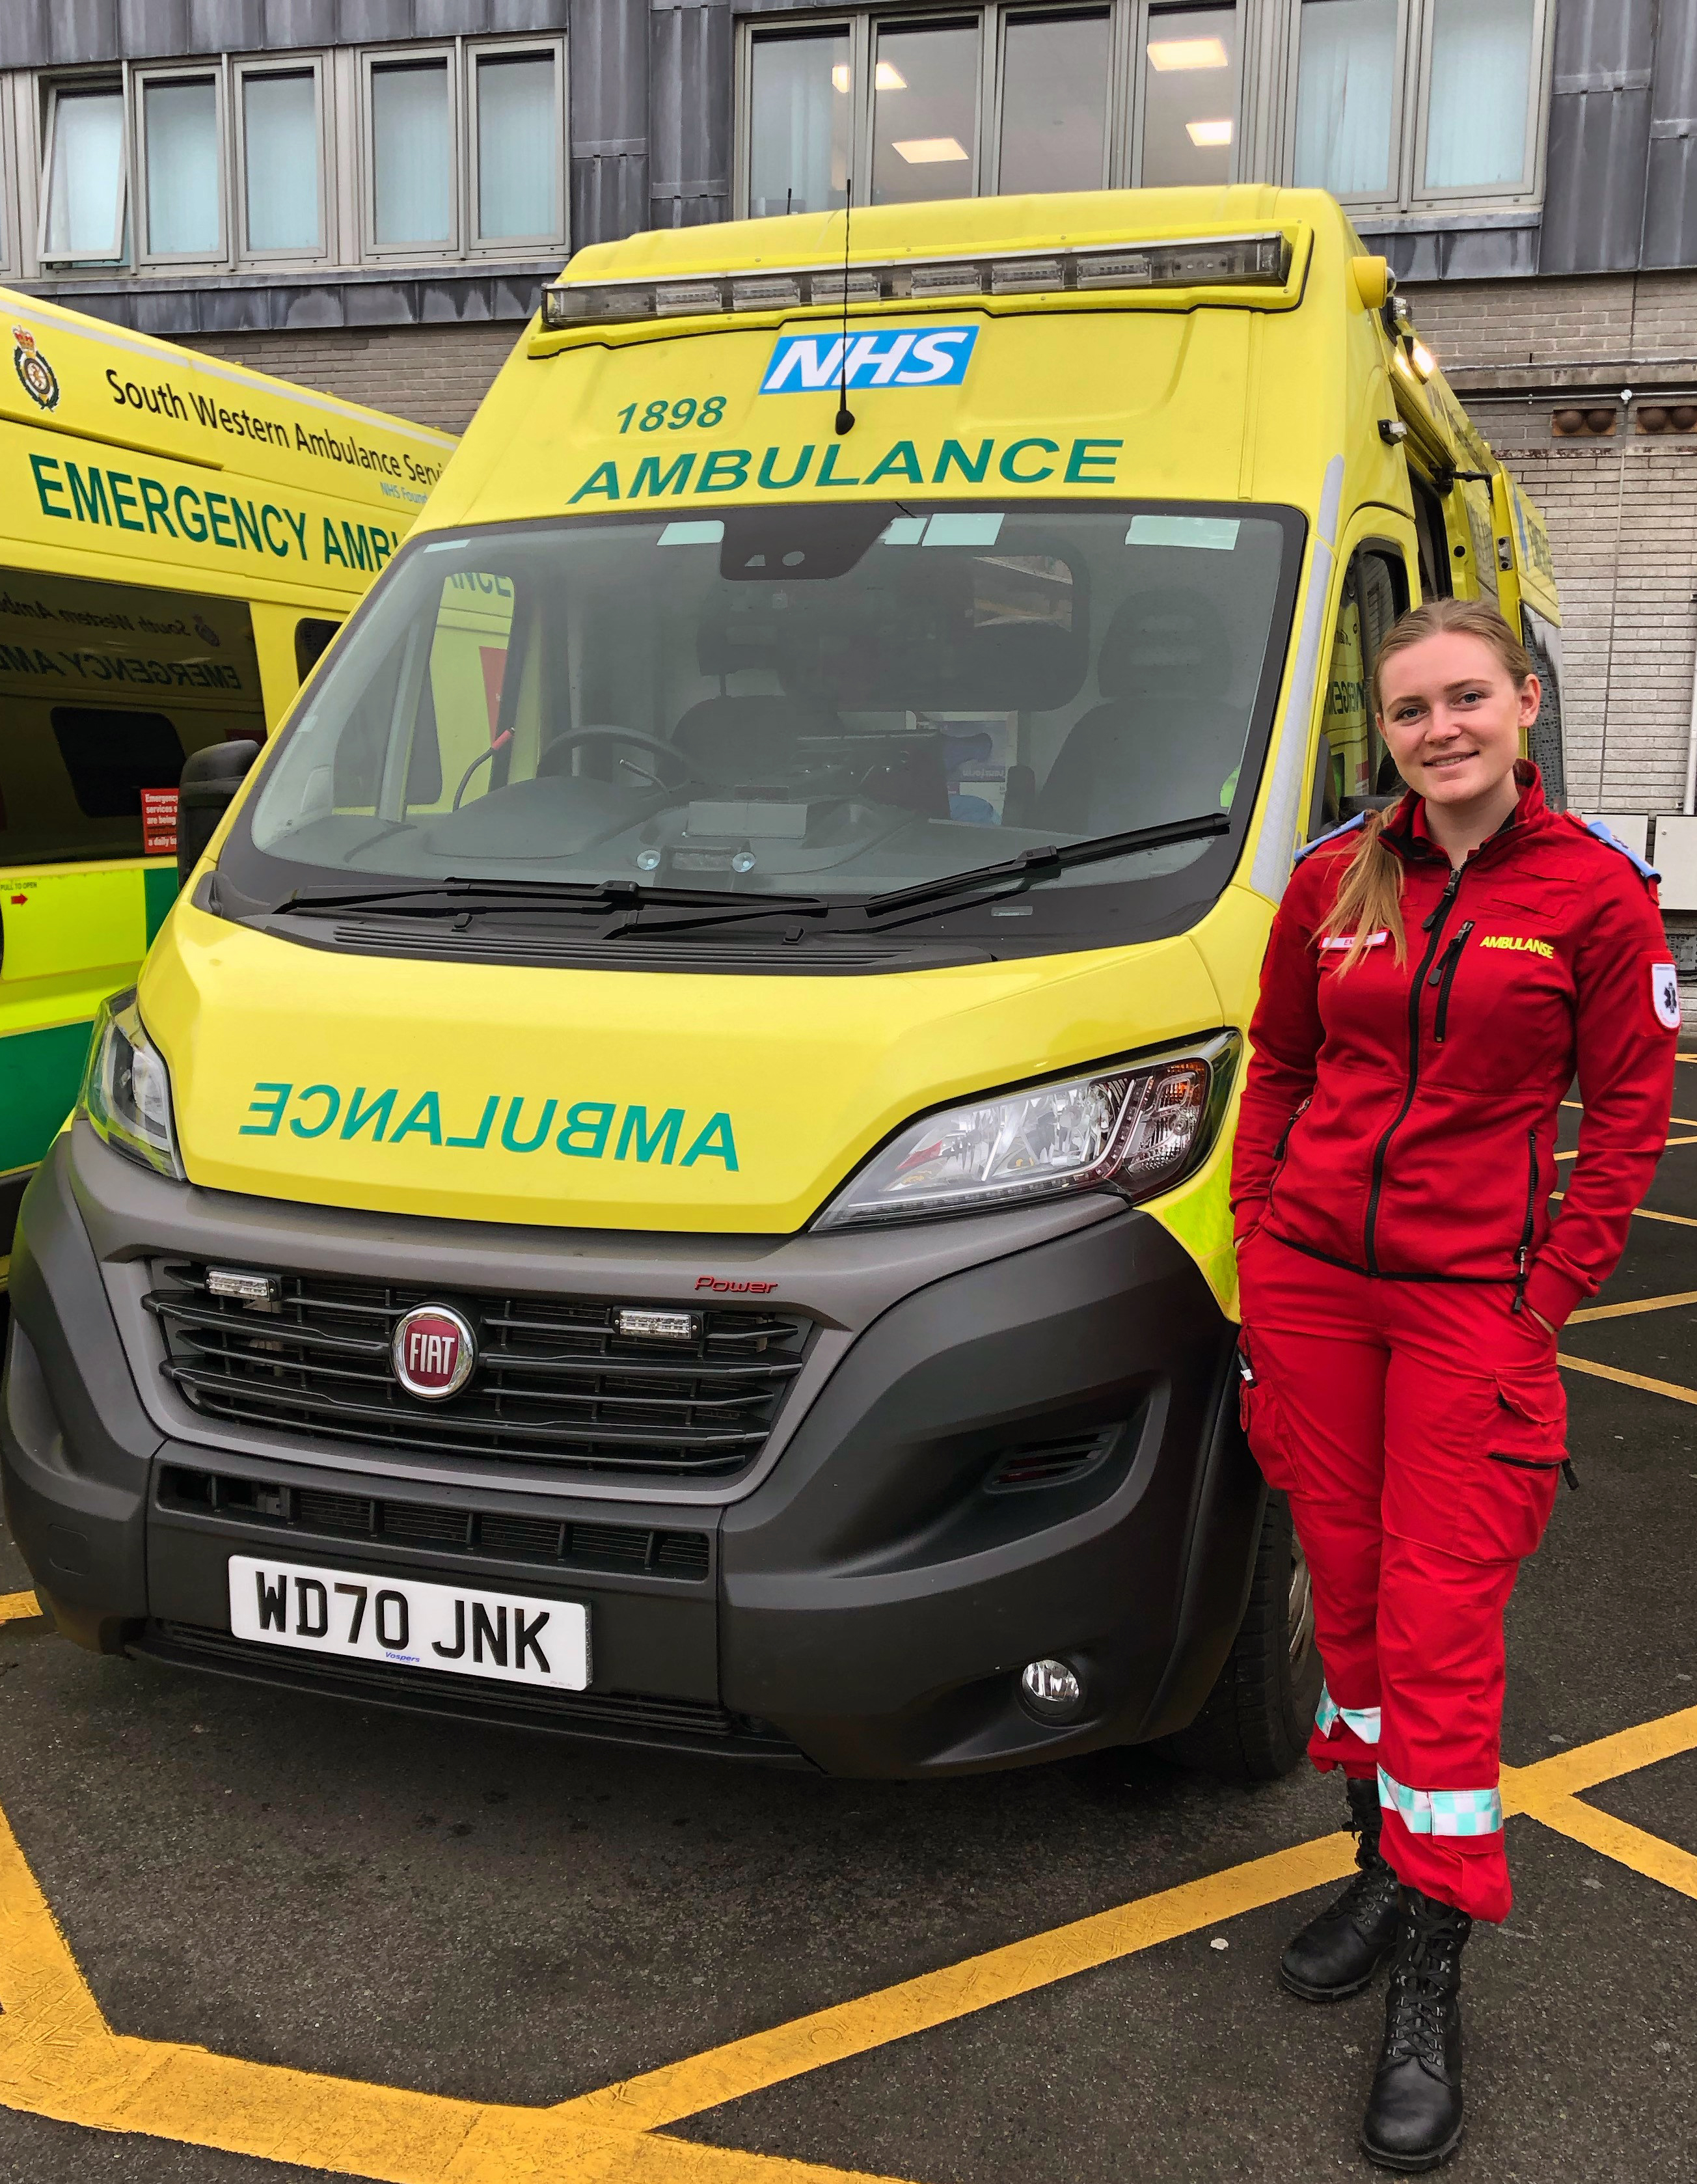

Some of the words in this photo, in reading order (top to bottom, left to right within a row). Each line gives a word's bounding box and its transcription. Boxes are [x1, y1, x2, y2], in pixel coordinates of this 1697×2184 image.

[765, 332, 967, 389] NHS
[105, 368, 188, 422] South
[189, 390, 291, 449] Western
[295, 426, 401, 478] Ambulance
[616, 396, 727, 434] 1898
[379, 481, 400, 499] NHS
[566, 437, 1124, 506] AMBULANCE
[29, 453, 308, 562] EMERGENCY
[1479, 936, 1554, 959] AMBULANSE
[694, 1274, 778, 1294] Power
[409, 1333, 455, 1375] FIAT
[254, 1570, 409, 1651] WD70
[431, 1599, 551, 1674] JNK
[385, 1652, 420, 1663] Vospers
